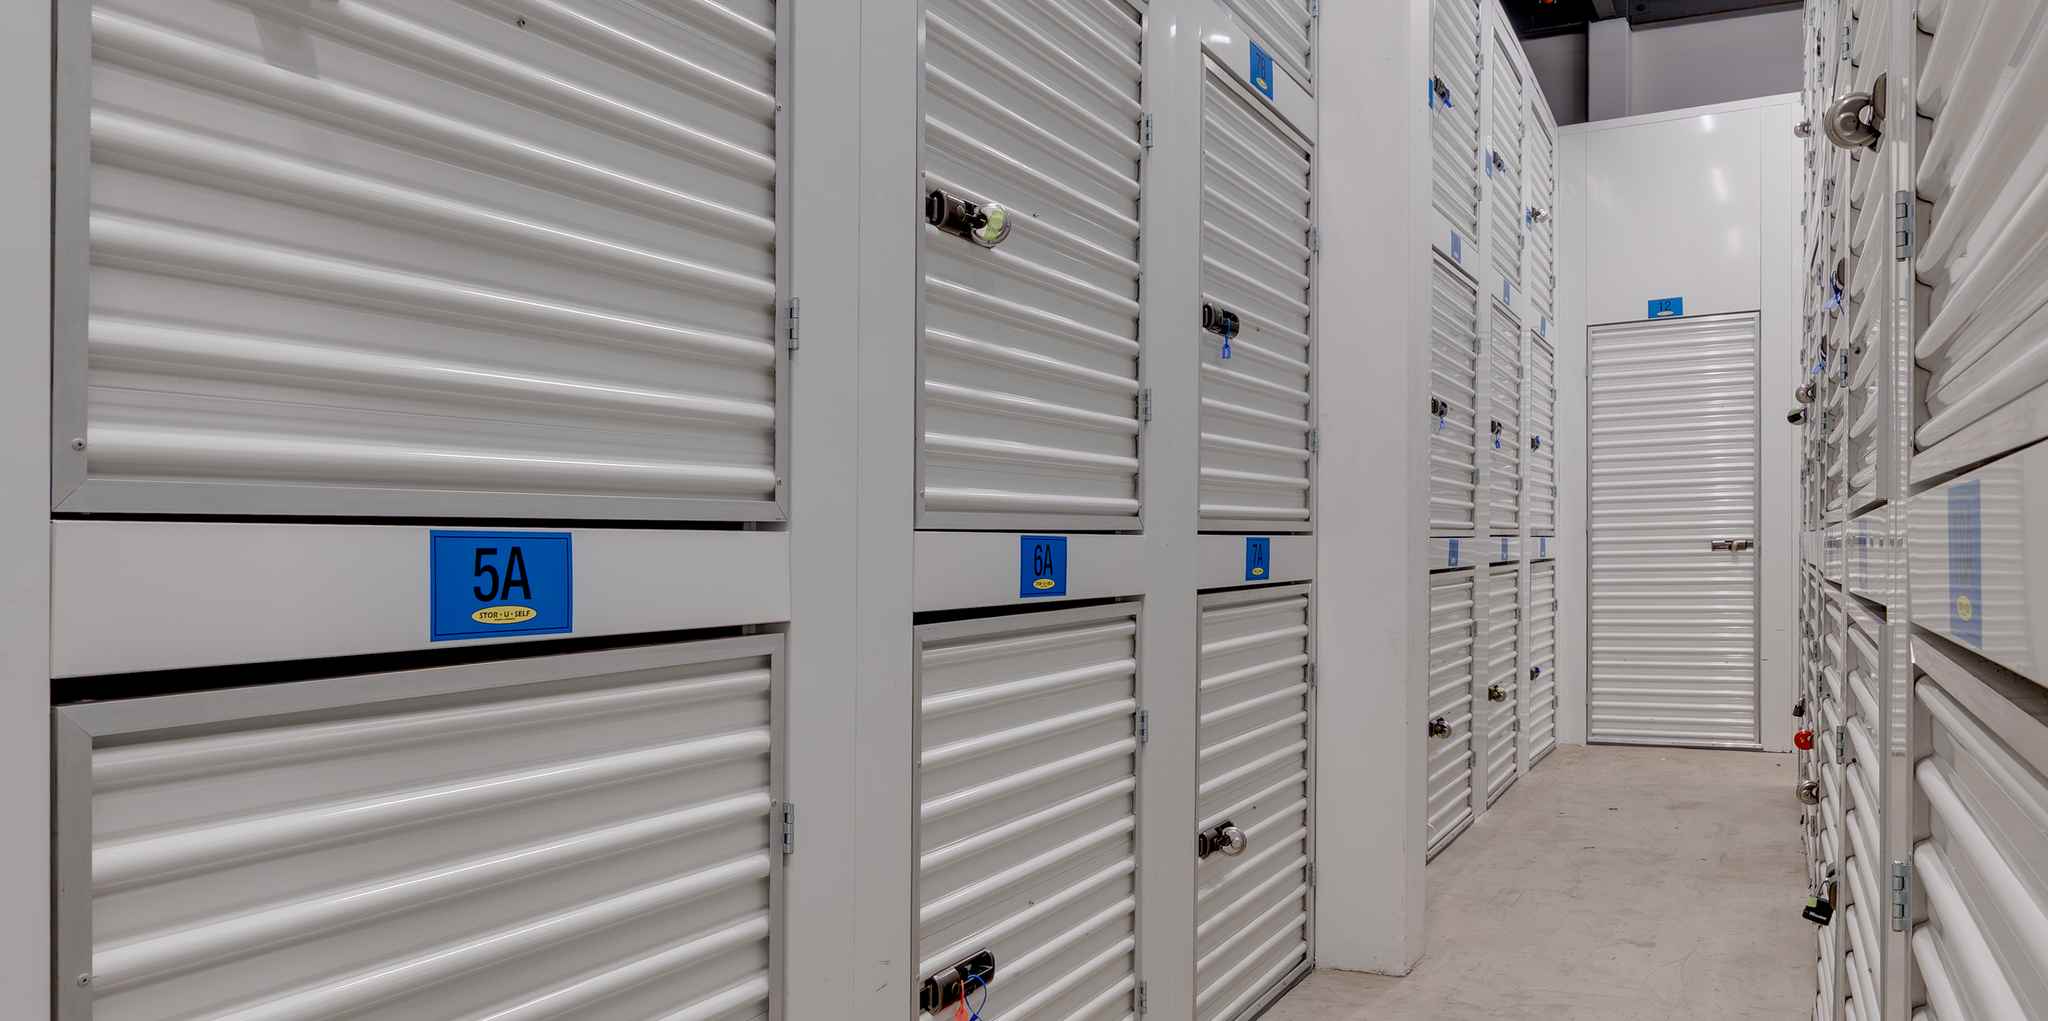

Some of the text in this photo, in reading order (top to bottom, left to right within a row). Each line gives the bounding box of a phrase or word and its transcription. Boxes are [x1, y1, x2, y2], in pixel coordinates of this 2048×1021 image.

[1034, 544, 1053, 576] 6A
[1252, 543, 1264, 567] 7A
[473, 546, 532, 602] 5A
[479, 611, 498, 619] STOR
[514, 610, 531, 618] SELF
